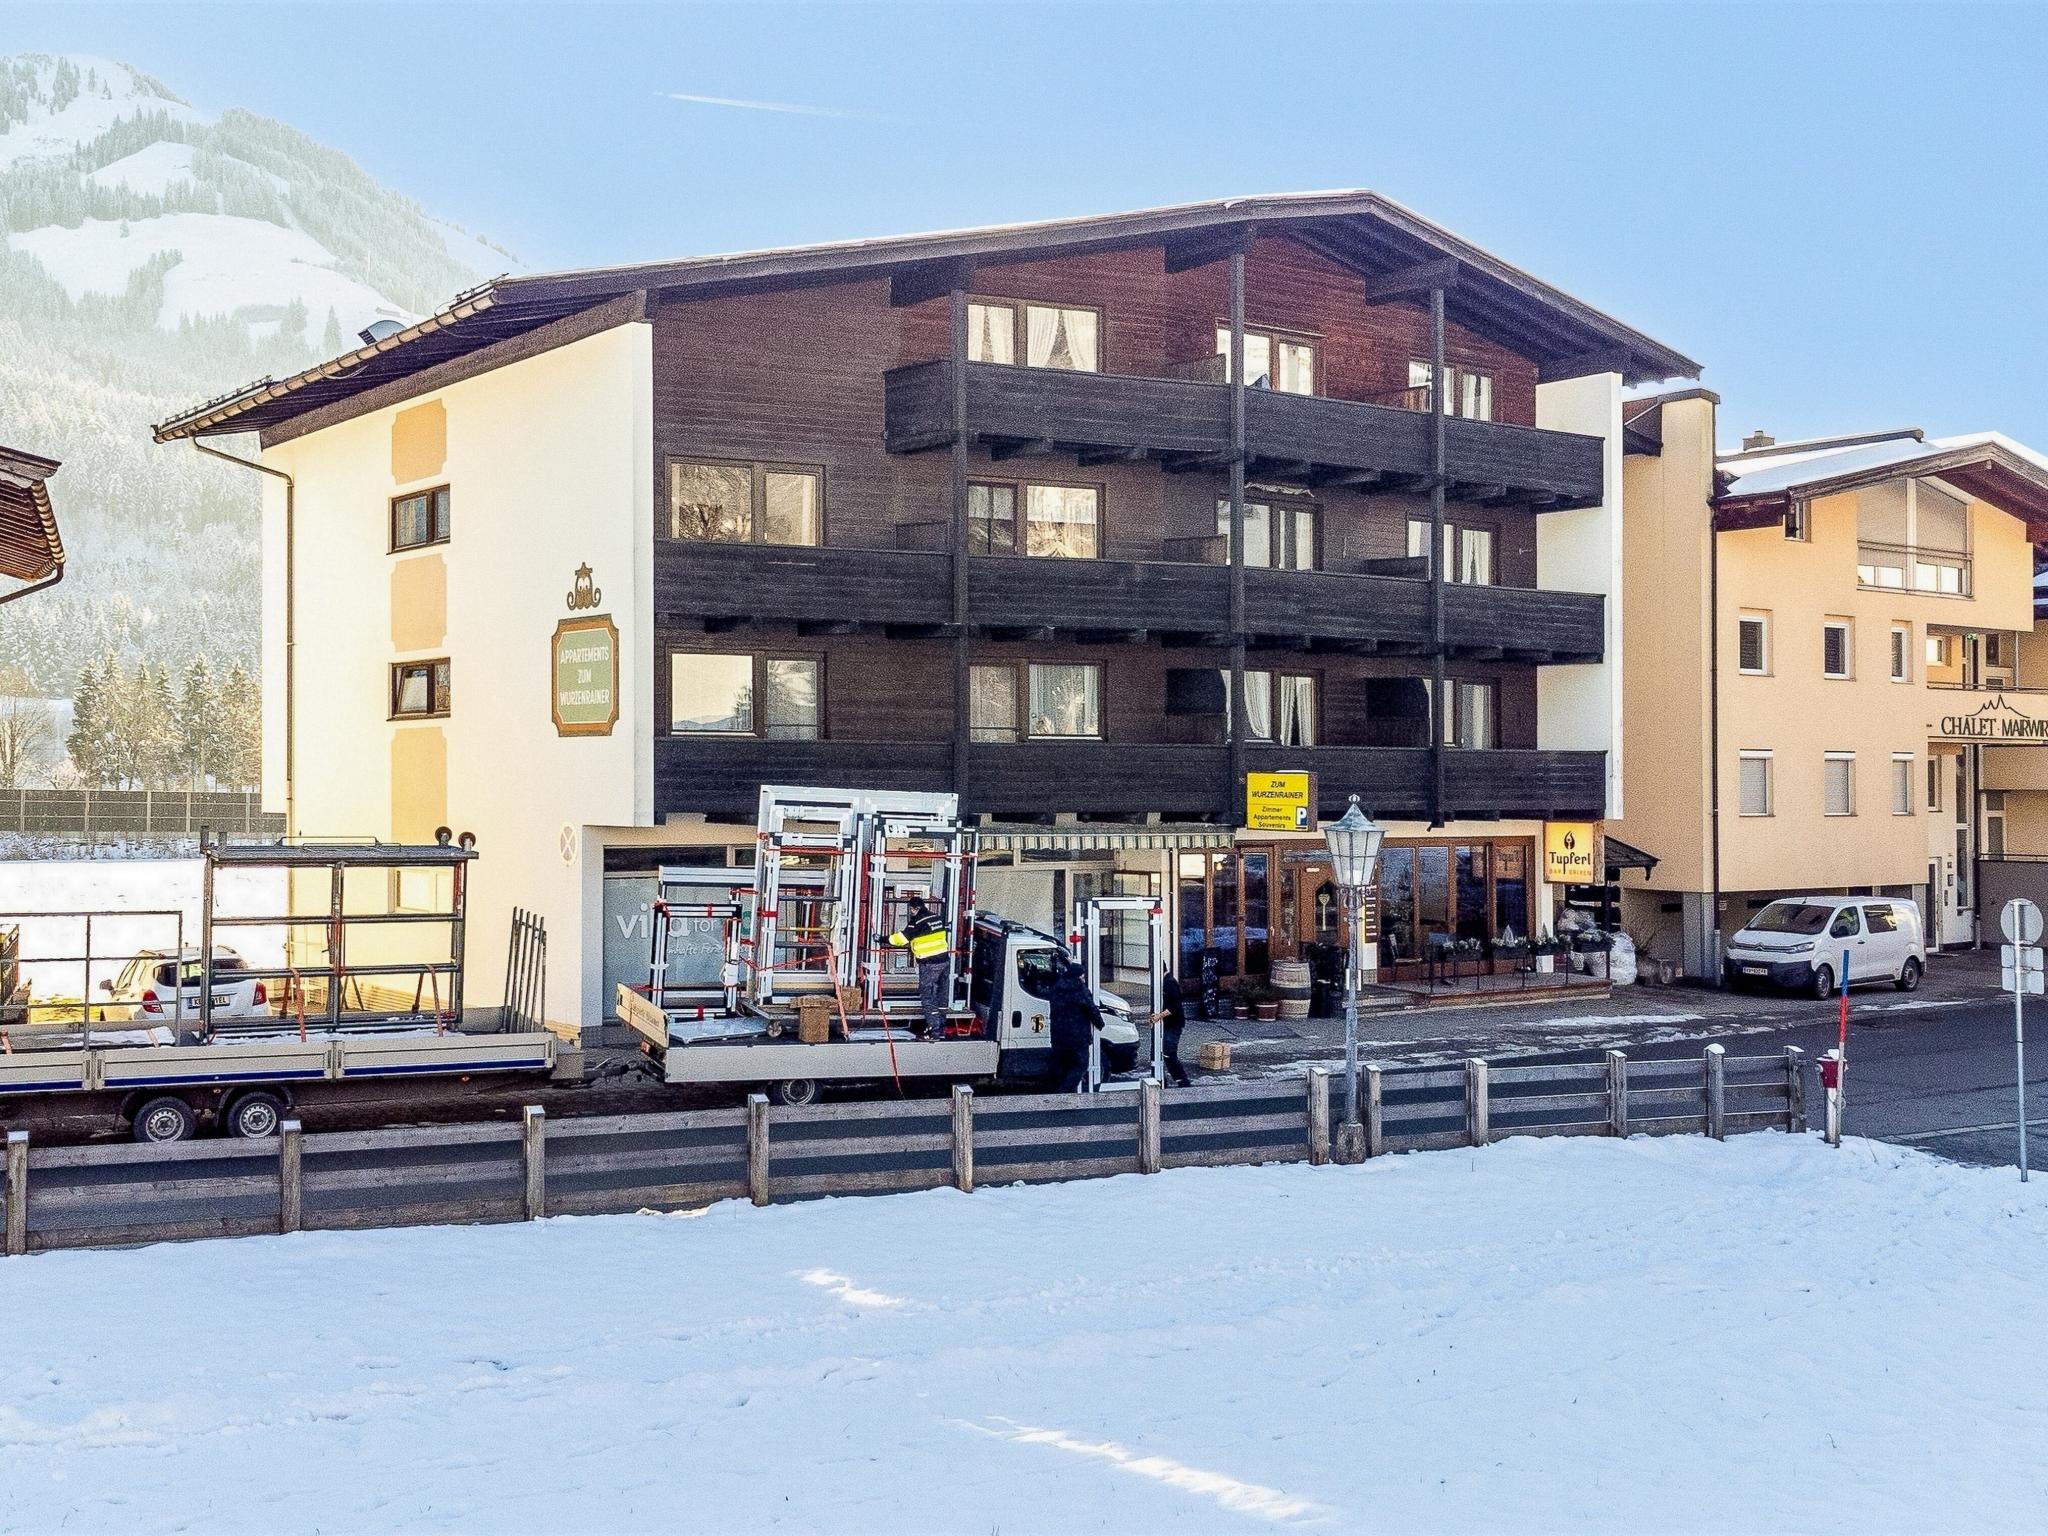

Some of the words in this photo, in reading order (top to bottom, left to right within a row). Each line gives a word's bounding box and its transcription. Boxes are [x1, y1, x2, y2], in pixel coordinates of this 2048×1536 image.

[560, 646, 609, 665] APPARTEMENTS
[577, 669, 592, 684] ZUM
[560, 689, 610, 706] WURZENRAINER
[1941, 716, 1997, 736] CHALET
[1252, 791, 1303, 799] WURZENRAINER
[1297, 807, 1306, 825] P
[1549, 852, 1591, 874] Tupferl
